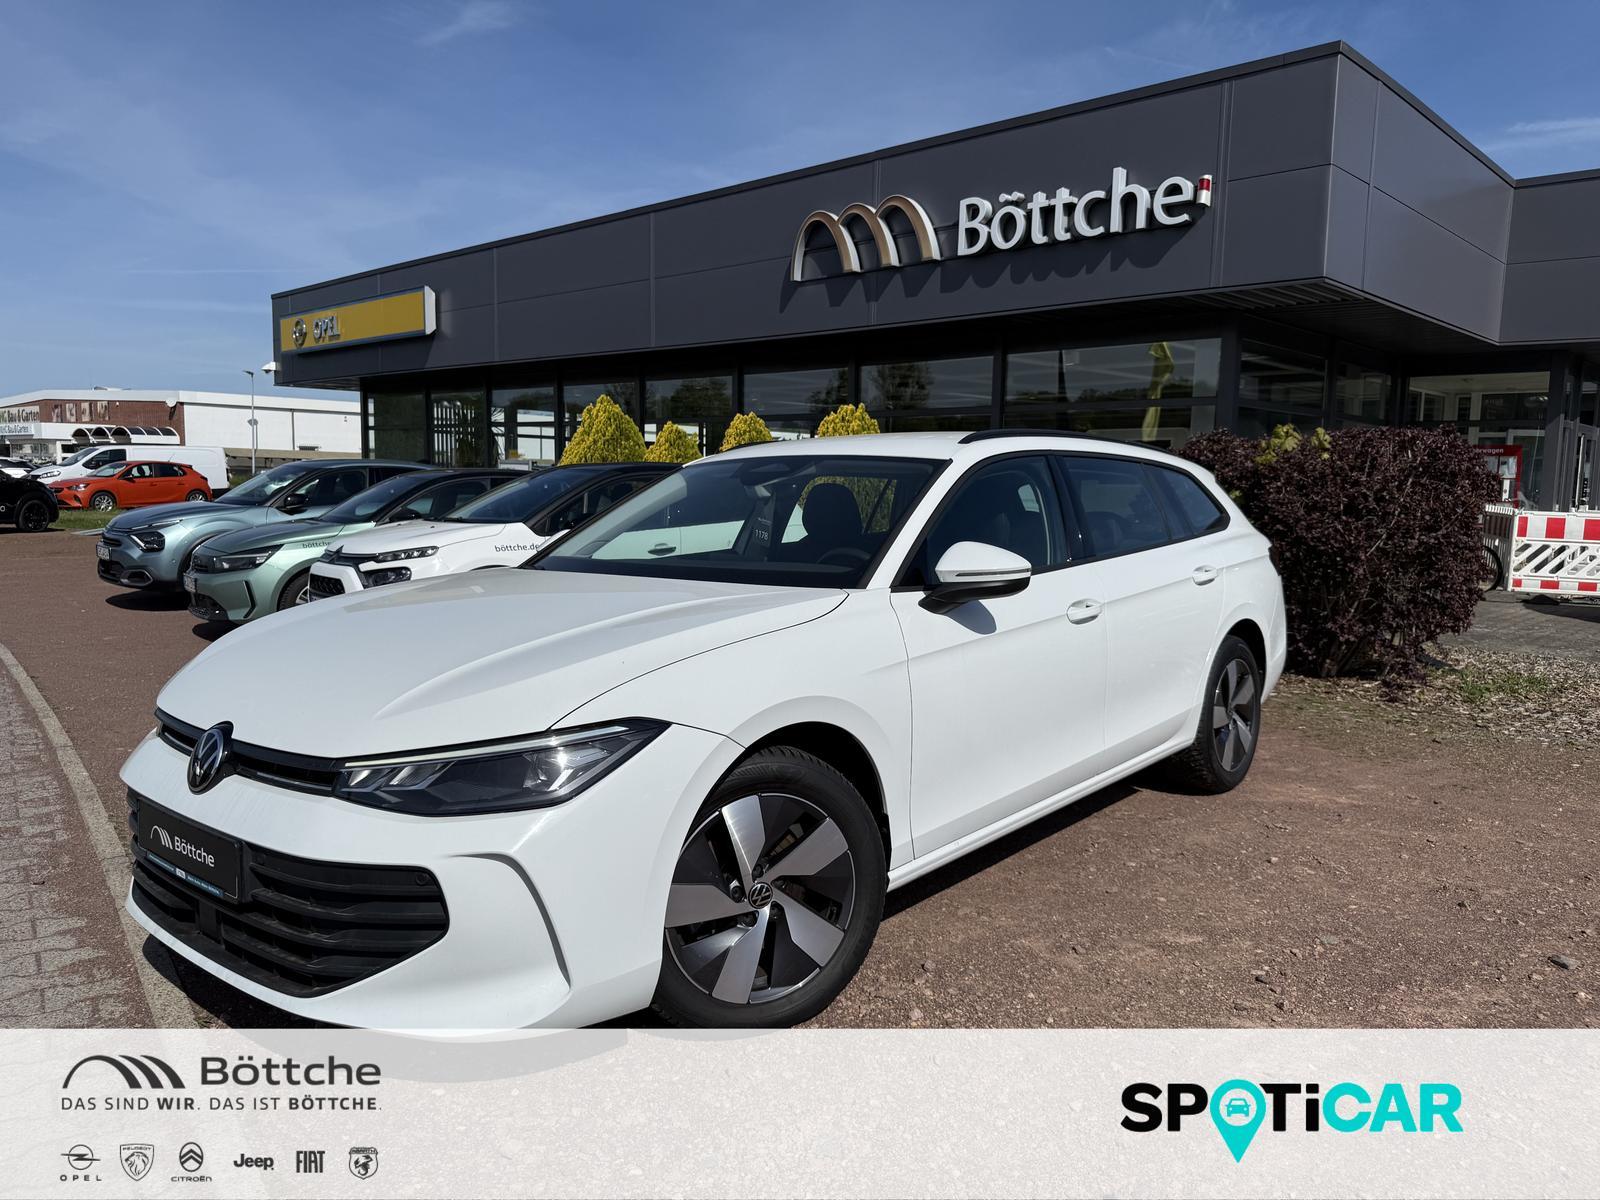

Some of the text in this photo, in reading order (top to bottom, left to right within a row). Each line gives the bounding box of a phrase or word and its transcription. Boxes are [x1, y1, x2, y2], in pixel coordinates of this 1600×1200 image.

[312, 315, 341, 341] OPEL
[22, 408, 40, 422] Garten
[755, 529, 769, 541] 1178
[174, 835, 215, 868] Böttche
